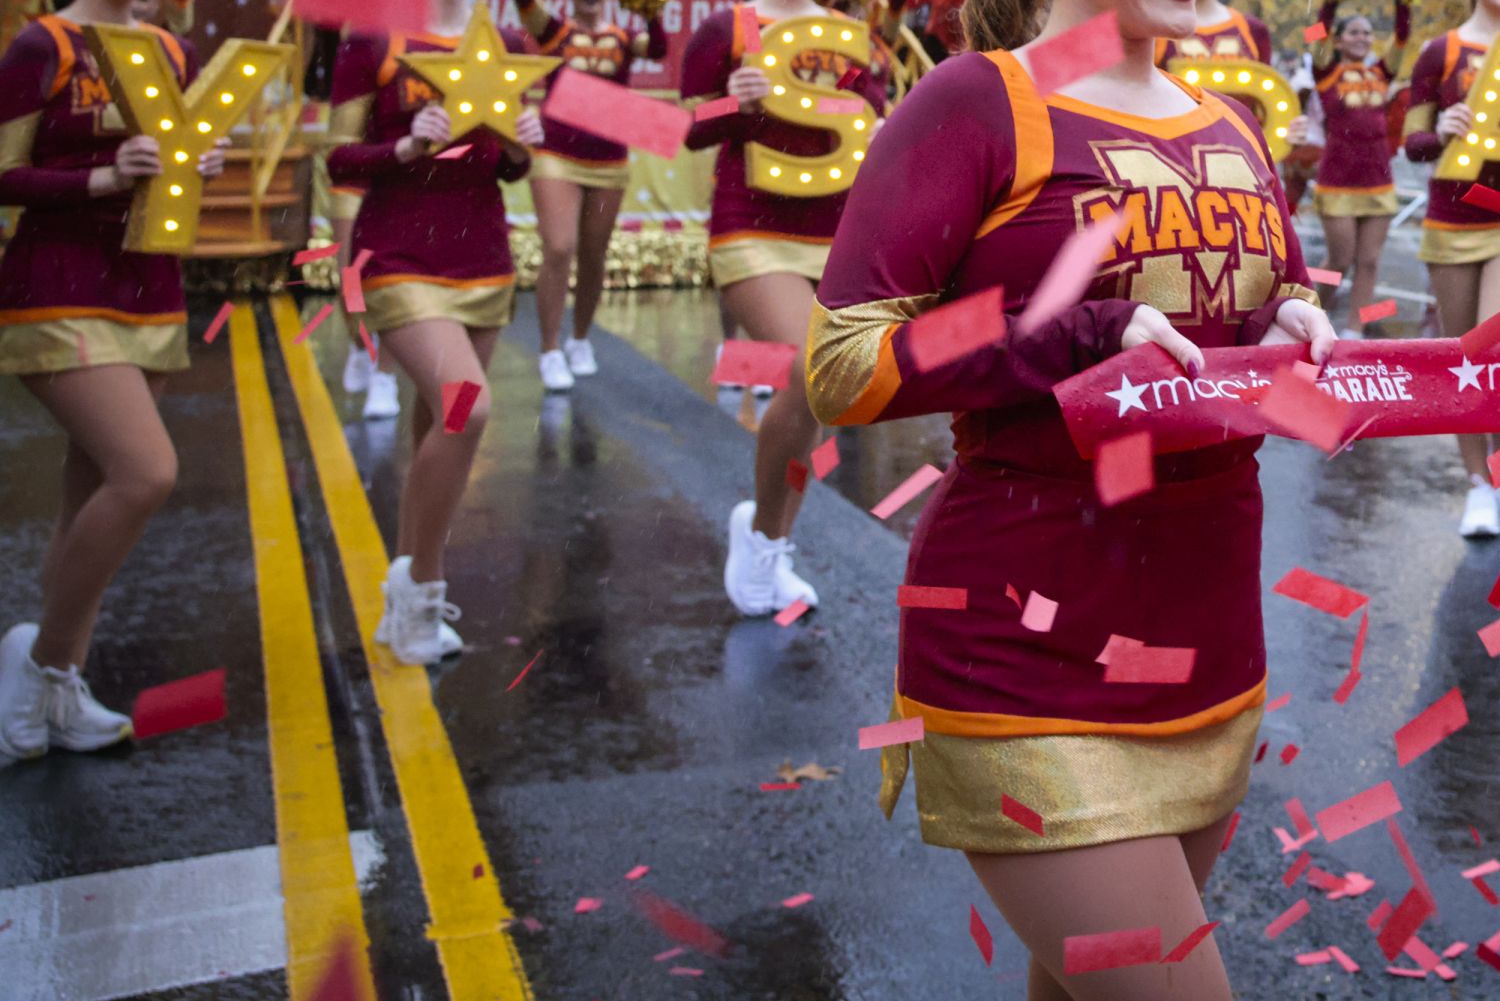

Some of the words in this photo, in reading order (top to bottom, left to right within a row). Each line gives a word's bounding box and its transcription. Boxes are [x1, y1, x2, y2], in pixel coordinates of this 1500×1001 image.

[81, 23, 297, 254] Y
[746, 15, 877, 197] S
[1089, 190, 1287, 264] MACYS
